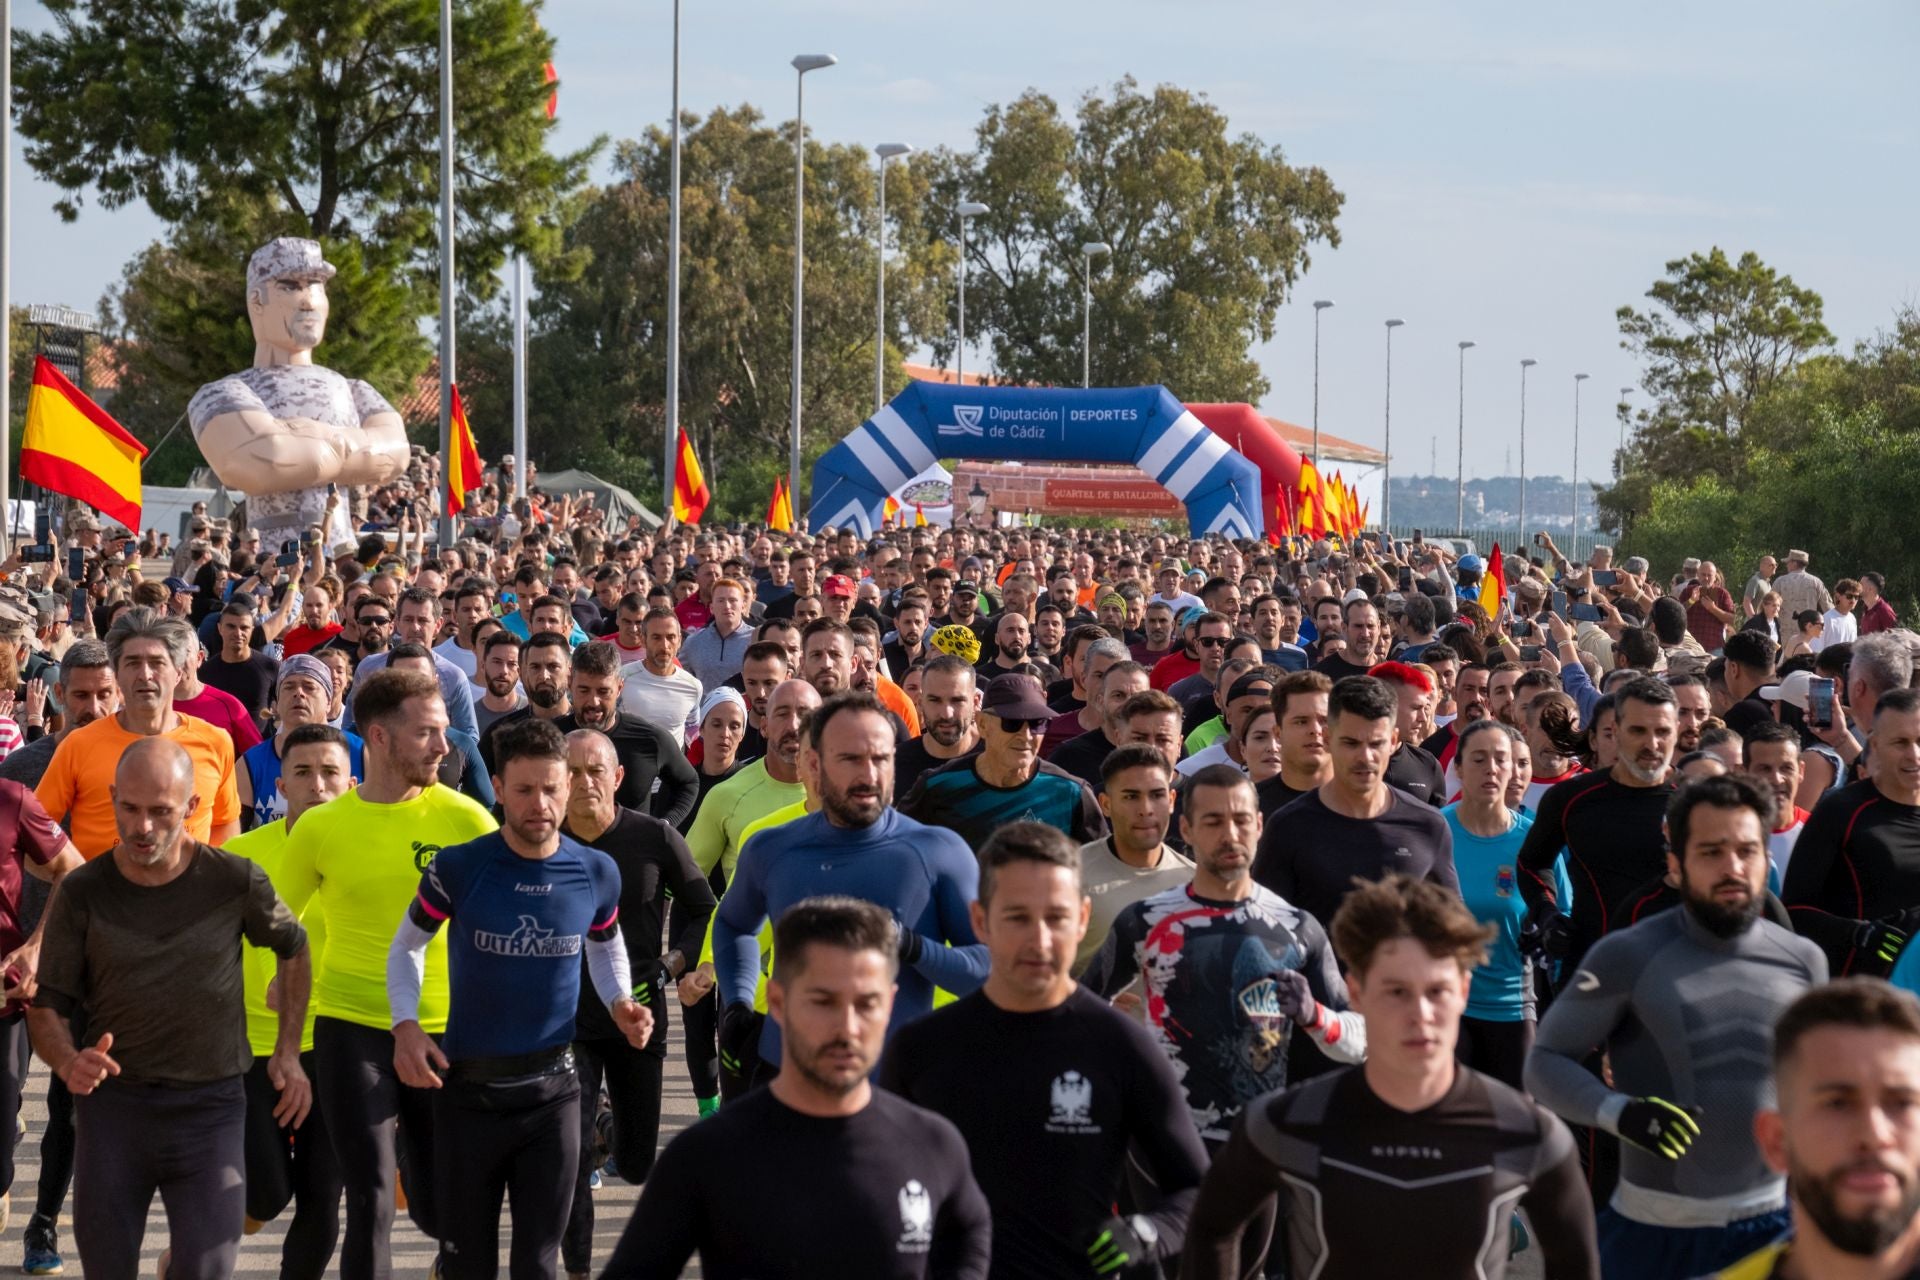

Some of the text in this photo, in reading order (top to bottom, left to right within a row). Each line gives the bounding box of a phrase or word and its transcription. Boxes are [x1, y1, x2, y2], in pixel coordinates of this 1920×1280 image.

[989, 406, 1058, 421] Diputación
[1070, 408, 1138, 421] DEPORTES
[989, 424, 1045, 439] de Cádiz
[1097, 490, 1111, 500] DE
[1112, 490, 1173, 500] BATALLONES
[514, 882, 552, 893] land
[478, 932, 541, 955] ULTRA
